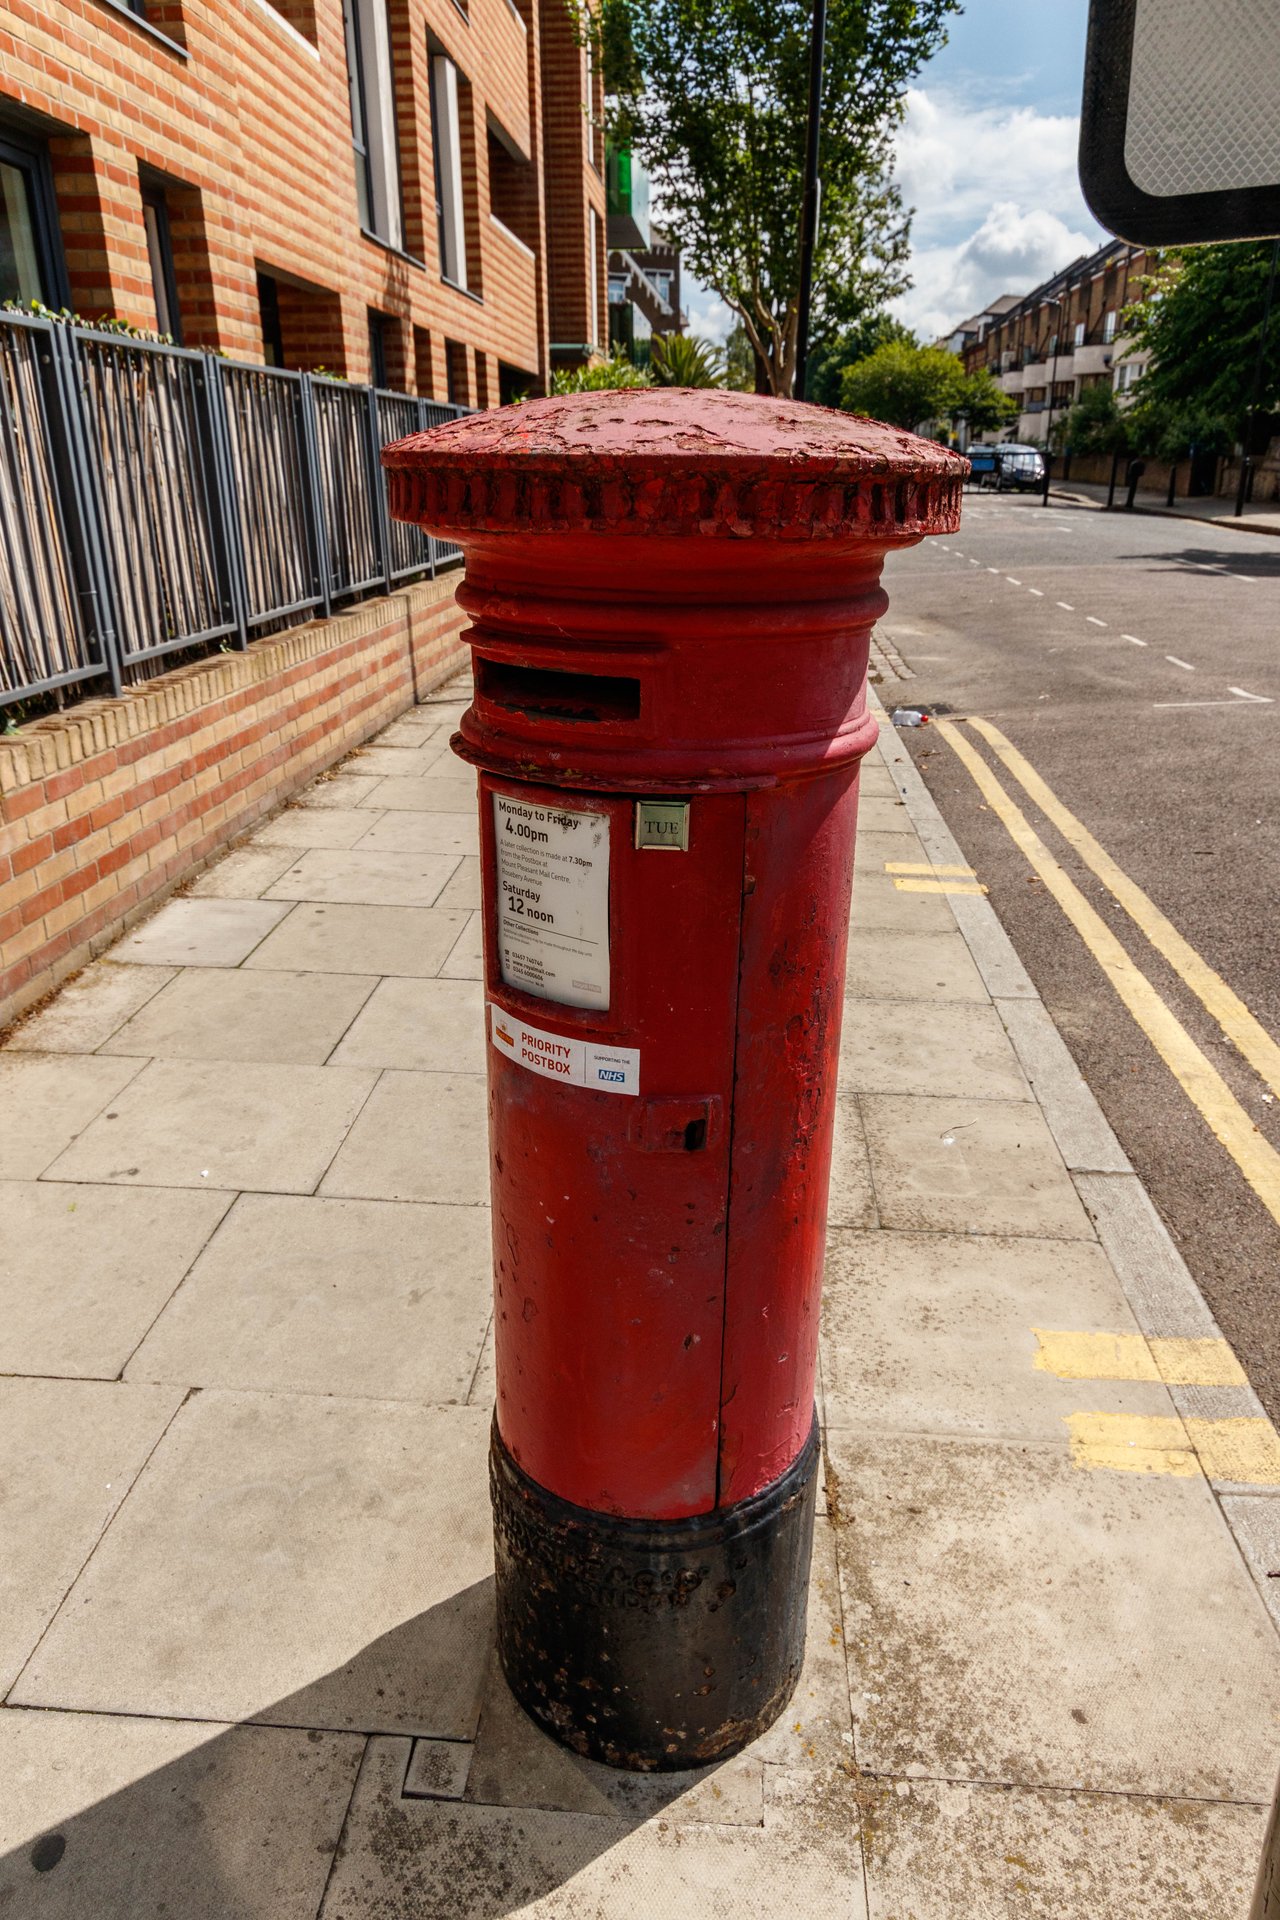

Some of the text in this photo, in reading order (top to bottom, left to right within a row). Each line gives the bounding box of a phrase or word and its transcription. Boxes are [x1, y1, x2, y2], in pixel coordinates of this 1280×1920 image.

[499, 801, 579, 830] Monday to Friday
[506, 818, 548, 843] 4.00pm
[645, 821, 678, 834] TUE
[501, 849, 513, 858] from
[513, 852, 521, 860] the
[522, 854, 541, 866] Postbox
[516, 844, 539, 856] collection
[546, 852, 561, 860] made
[569, 856, 593, 868] 7.30pm
[501, 859, 516, 869] Mount
[517, 864, 538, 875] Pleasant
[539, 870, 550, 878] Mail
[502, 868, 542, 886] Rosebery Avenue
[503, 881, 541, 903] Saturday
[509, 896, 554, 923] 12 noon
[503, 920, 515, 928] Other
[516, 923, 538, 936] Collections
[513, 960, 556, 978] www.royalmail.com
[522, 1032, 571, 1058] PRIORITY
[522, 1049, 571, 1075] POSTBOX
[594, 1056, 621, 1064] SUPPORTING
[600, 1071, 624, 1082] NHS
